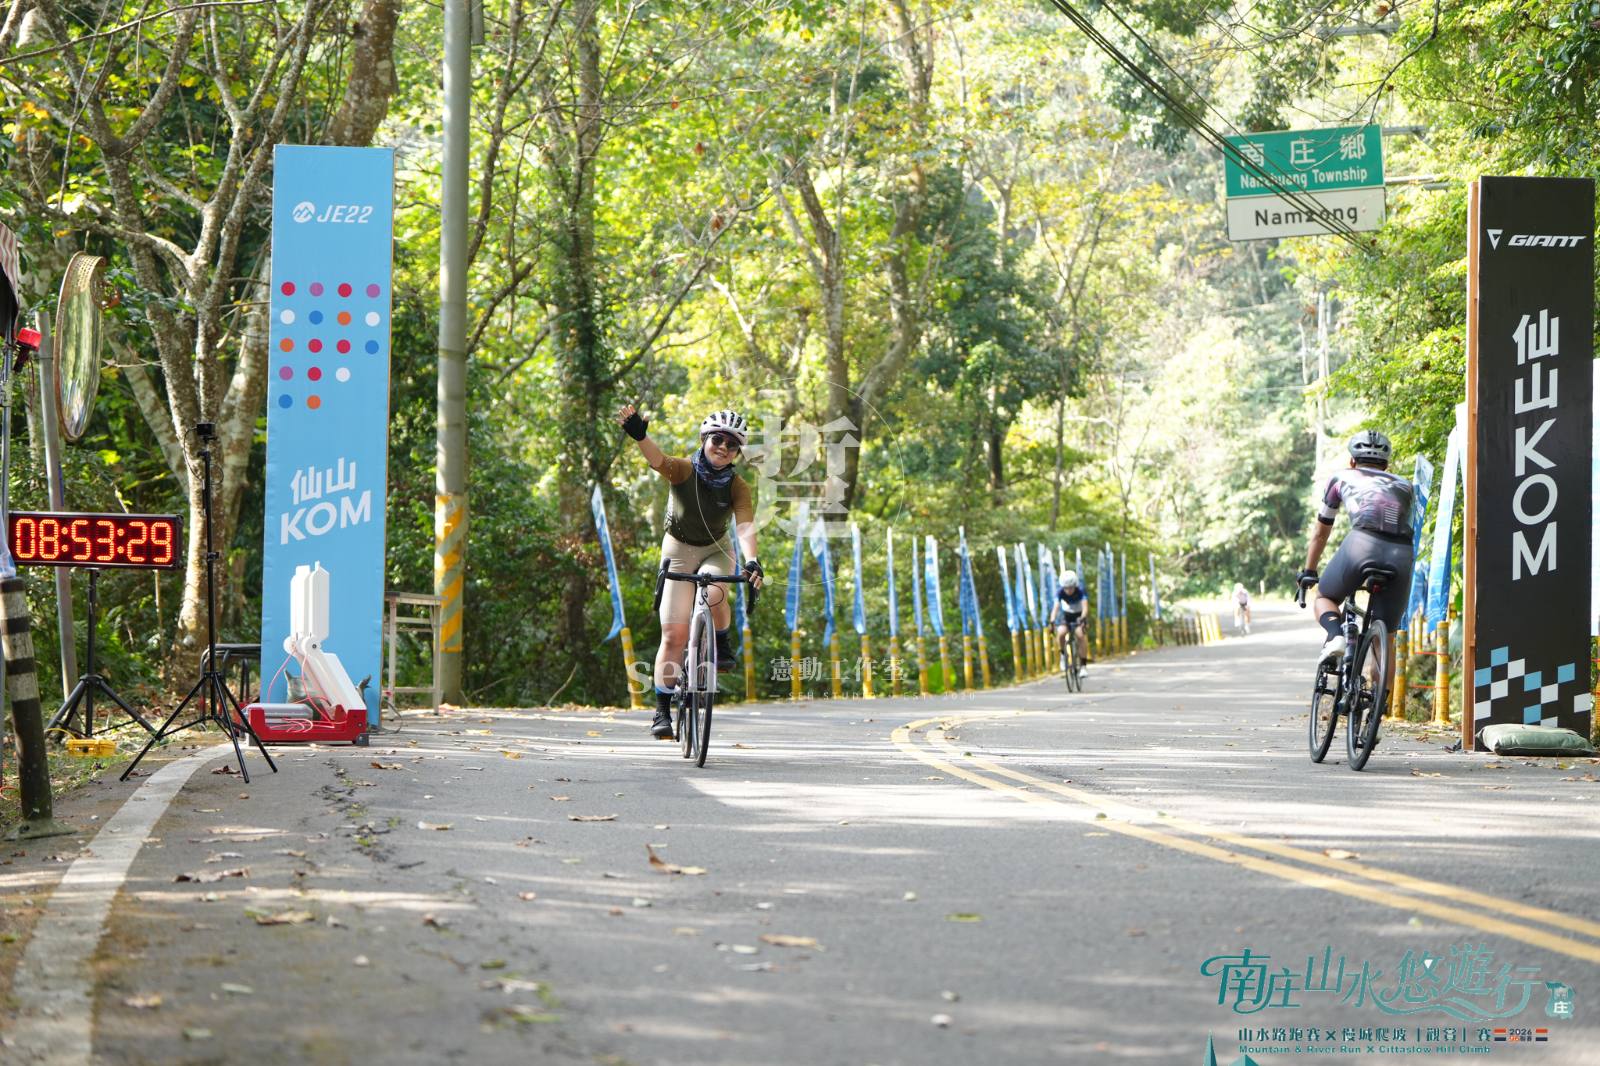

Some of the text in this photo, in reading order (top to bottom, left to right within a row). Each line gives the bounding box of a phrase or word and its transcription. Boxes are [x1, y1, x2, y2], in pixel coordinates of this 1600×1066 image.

[1238, 132, 1367, 168] 南庄鄉
[1312, 166, 1368, 184] Township
[316, 205, 374, 224] JE22
[1254, 206, 1358, 227] Namzong
[1508, 234, 1587, 248] GIANT
[289, 456, 357, 506] 仙山
[279, 489, 372, 546] KOM
[15, 518, 173, 563] 08:53:29
